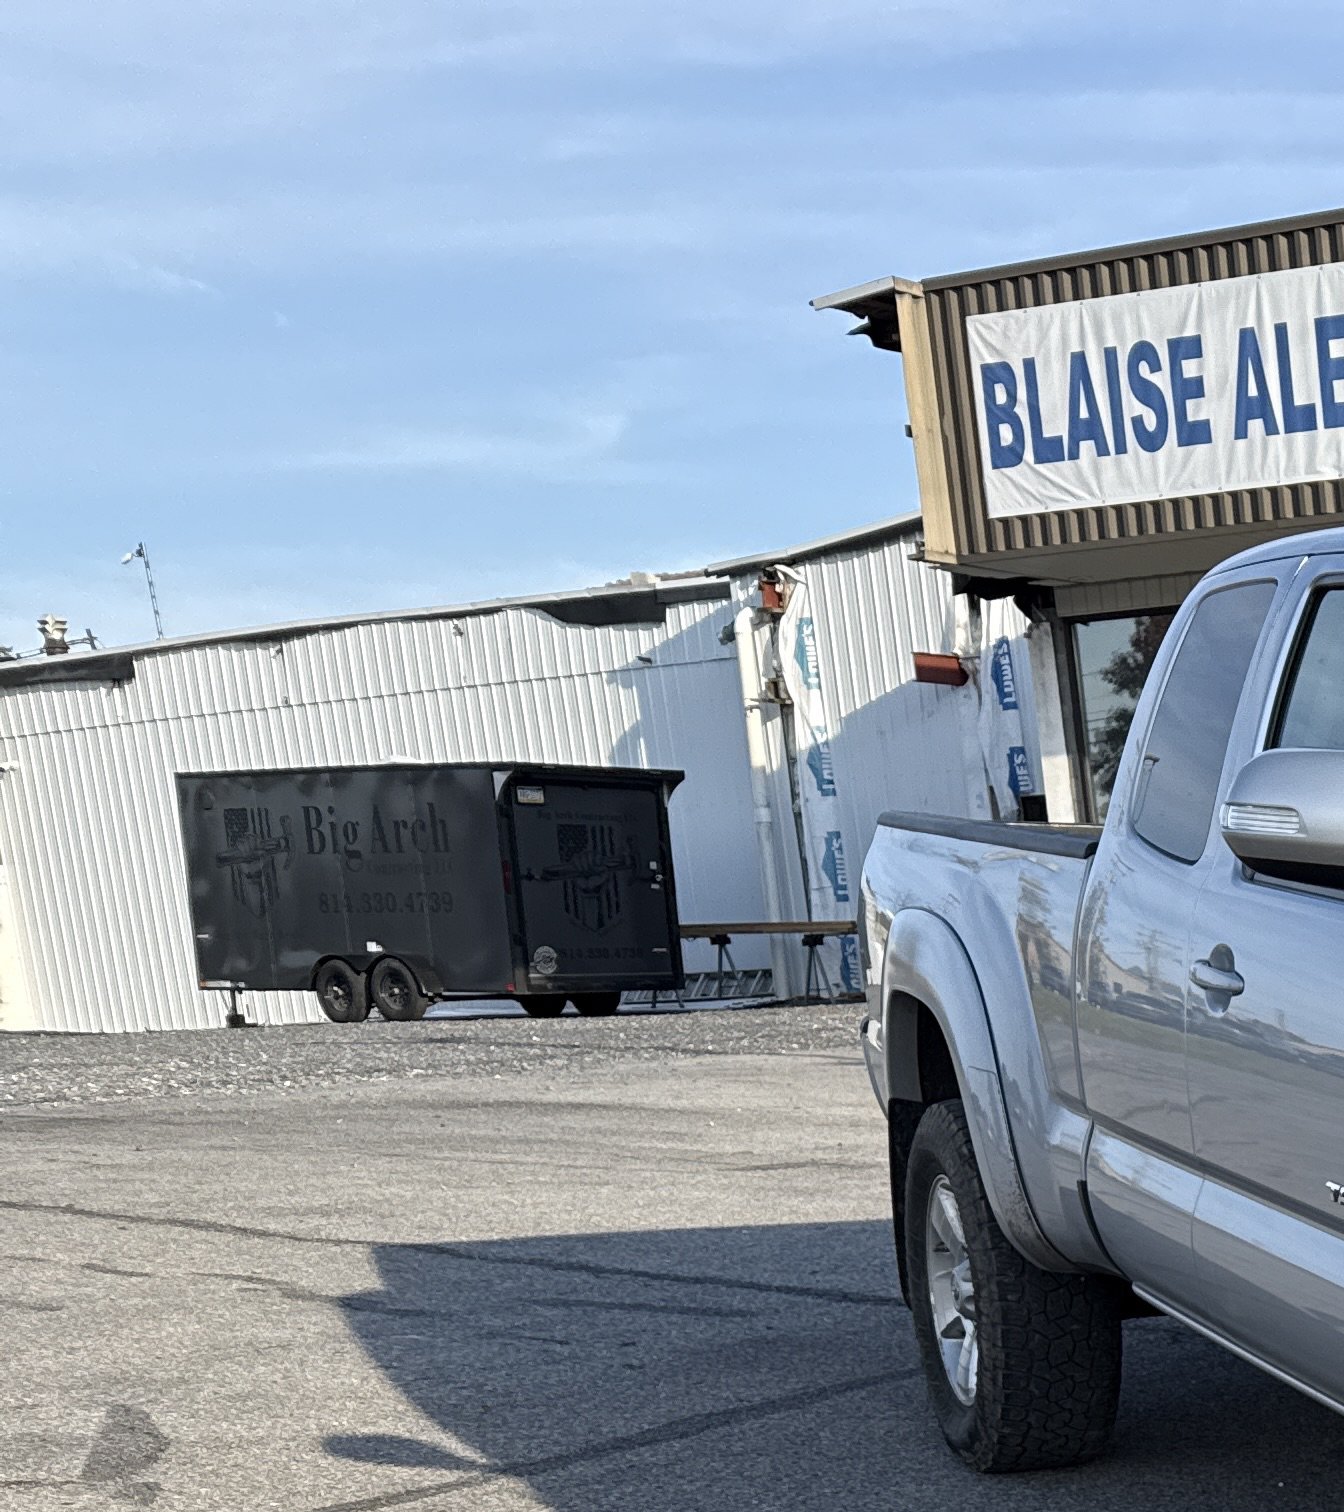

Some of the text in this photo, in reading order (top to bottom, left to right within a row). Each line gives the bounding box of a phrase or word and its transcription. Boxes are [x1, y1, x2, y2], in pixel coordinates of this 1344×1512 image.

[980, 335, 1210, 471] BLAISE
[301, 801, 450, 872] Big Arch
